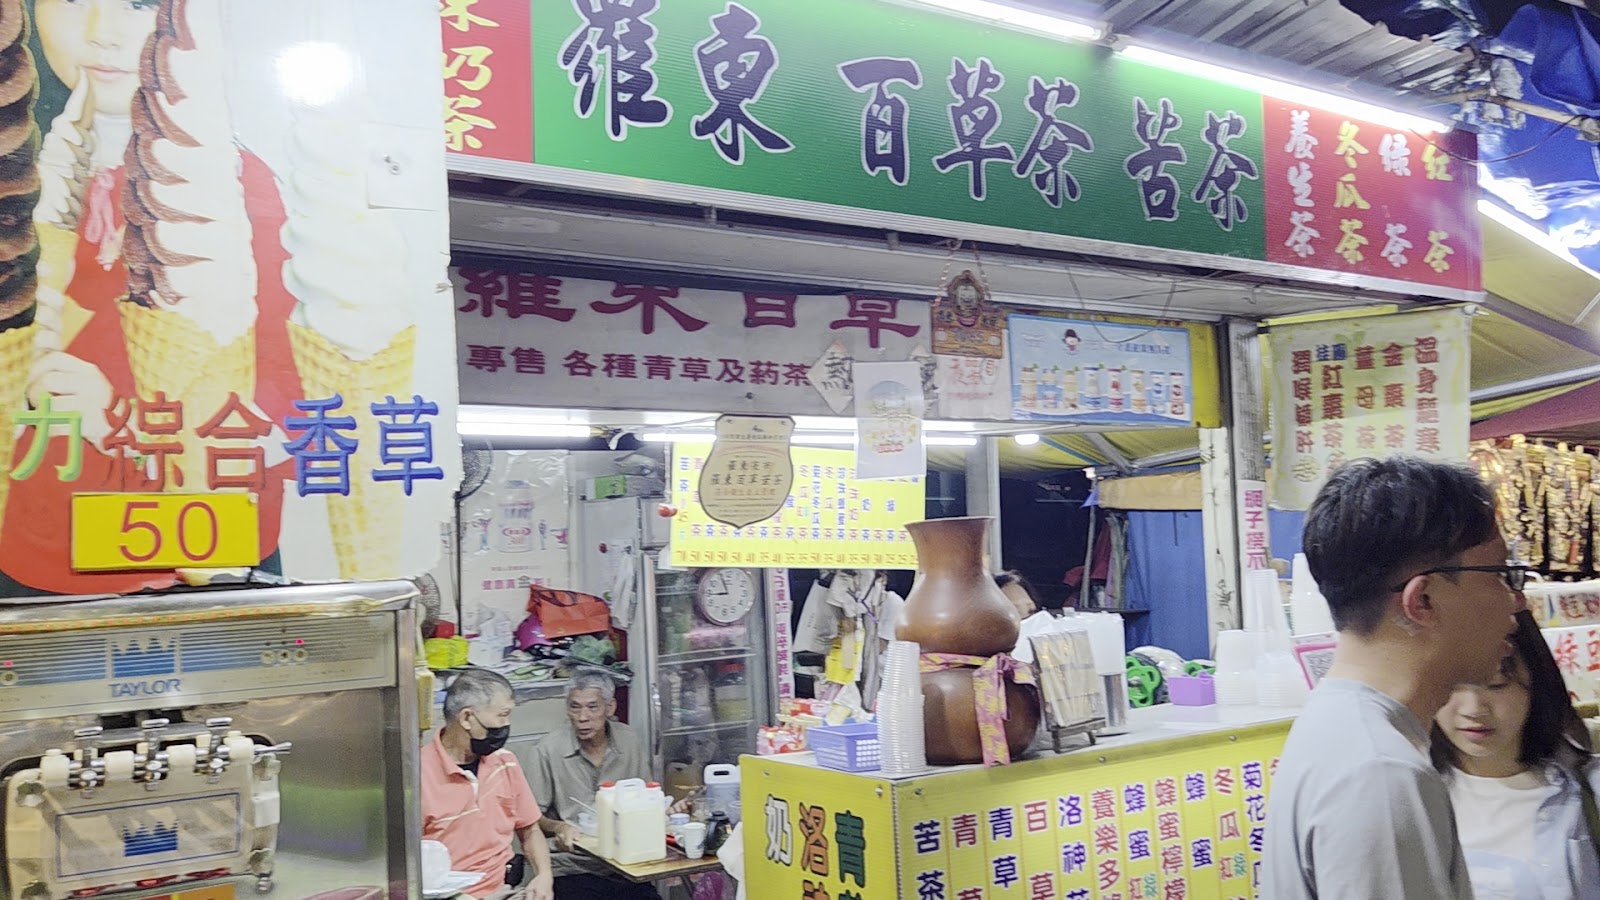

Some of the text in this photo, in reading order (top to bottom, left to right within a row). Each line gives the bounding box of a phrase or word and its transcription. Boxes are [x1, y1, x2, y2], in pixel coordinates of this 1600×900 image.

[837, 56, 1094, 208] 百草茶
[1122, 97, 1259, 231] 苦茶
[1284, 110, 1320, 258] 養生茶
[1333, 120, 1371, 265] 冬瓜茶
[466, 344, 547, 375] 專售
[103, 390, 273, 492] 綜合
[282, 393, 444, 497] 香草
[118, 501, 219, 562] 50
[109, 677, 182, 699] TAYLOR
[835, 810, 866, 900] 青
[913, 820, 945, 900] 苦茶
[988, 807, 1018, 888] 青草
[1091, 789, 1121, 900] 養樂多
[1186, 773, 1212, 868] 蜂蜜
